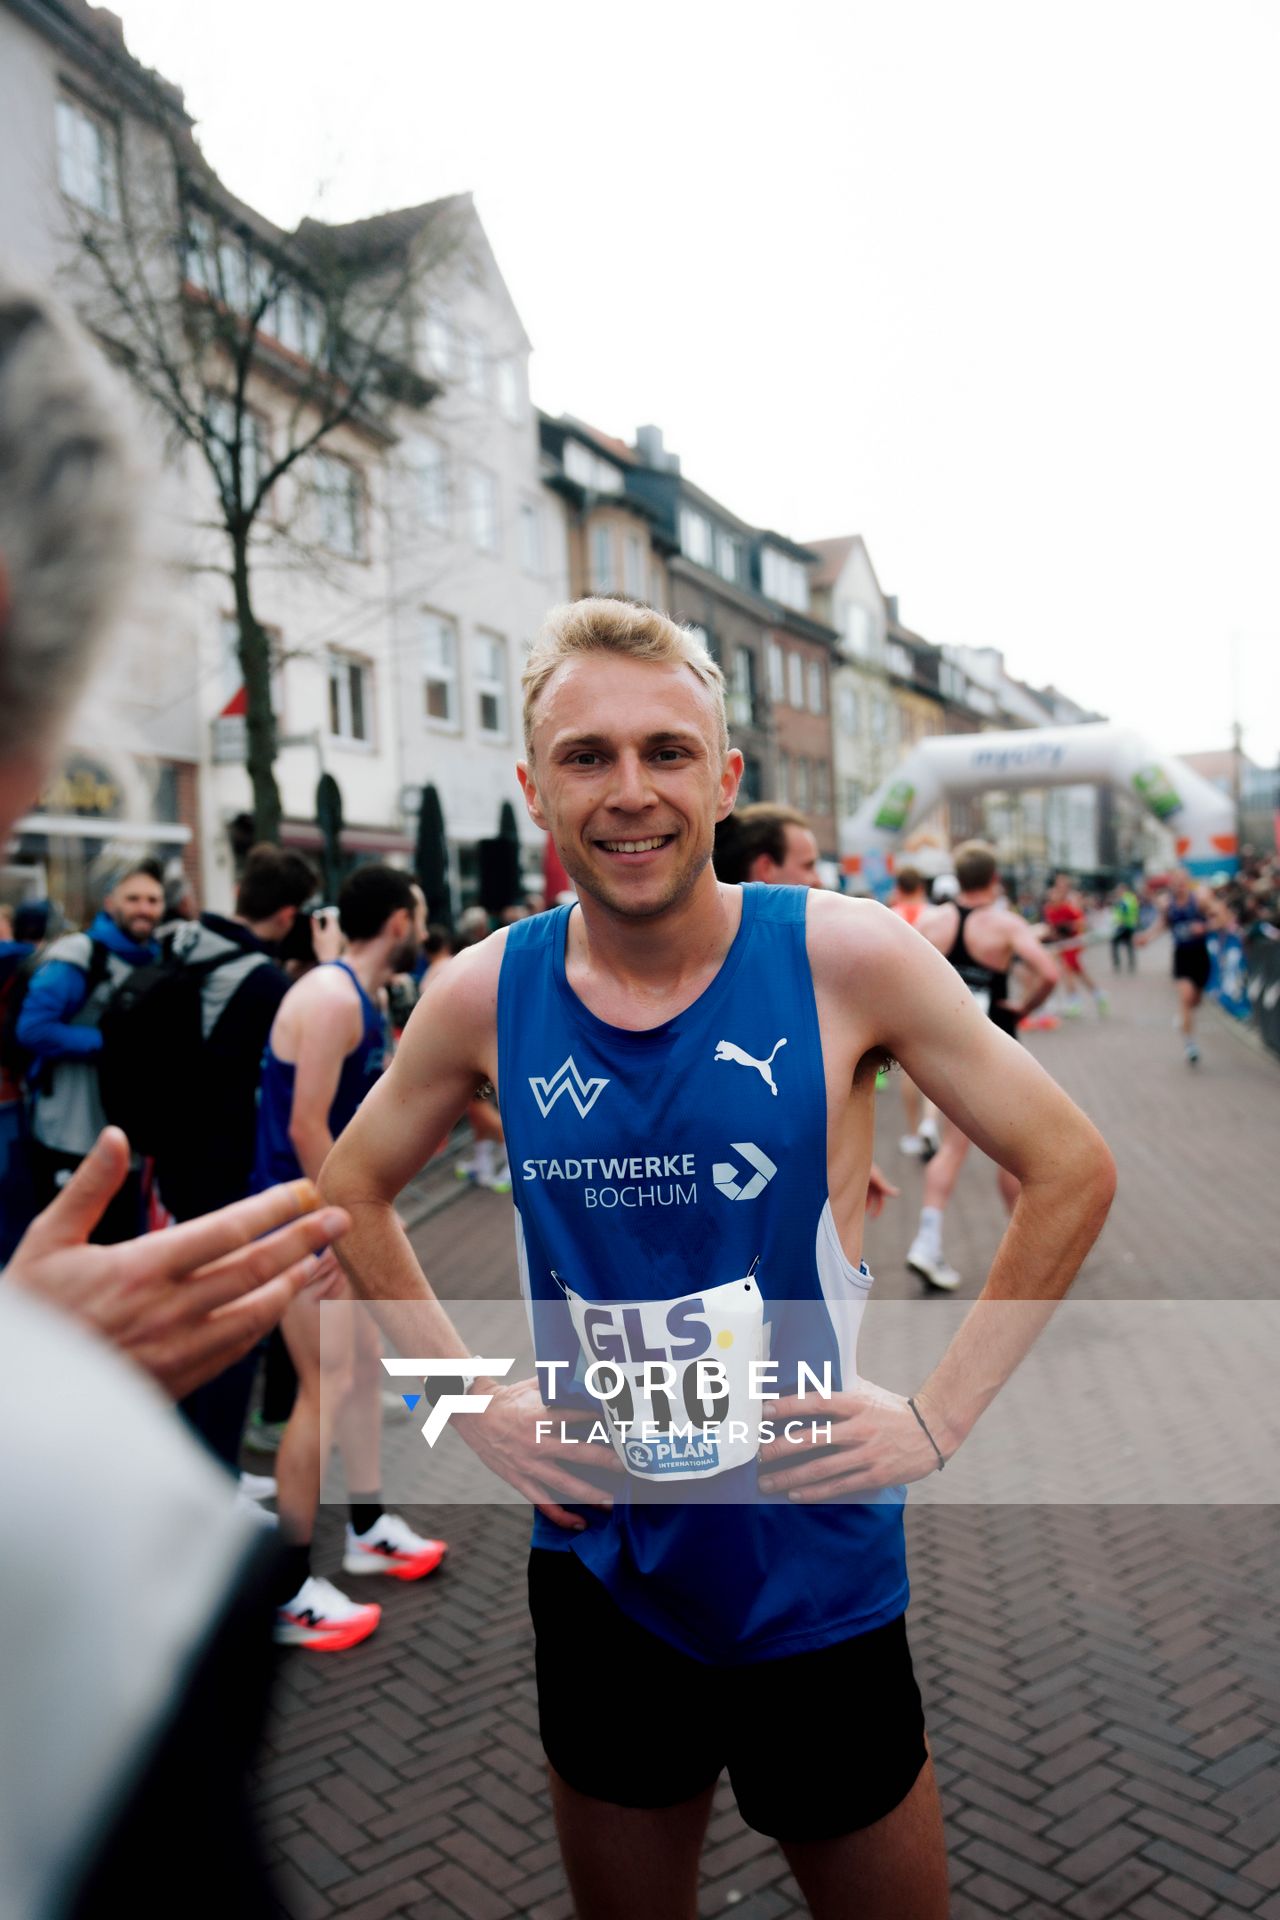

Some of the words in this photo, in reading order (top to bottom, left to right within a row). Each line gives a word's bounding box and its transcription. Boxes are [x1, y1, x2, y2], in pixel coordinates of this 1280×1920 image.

[522, 1153, 696, 1180] STADTWERKE
[584, 1183, 697, 1208] BOCHUM
[656, 1441, 714, 1460] PLAN
[658, 1457, 715, 1468] INTERNATIONAL
